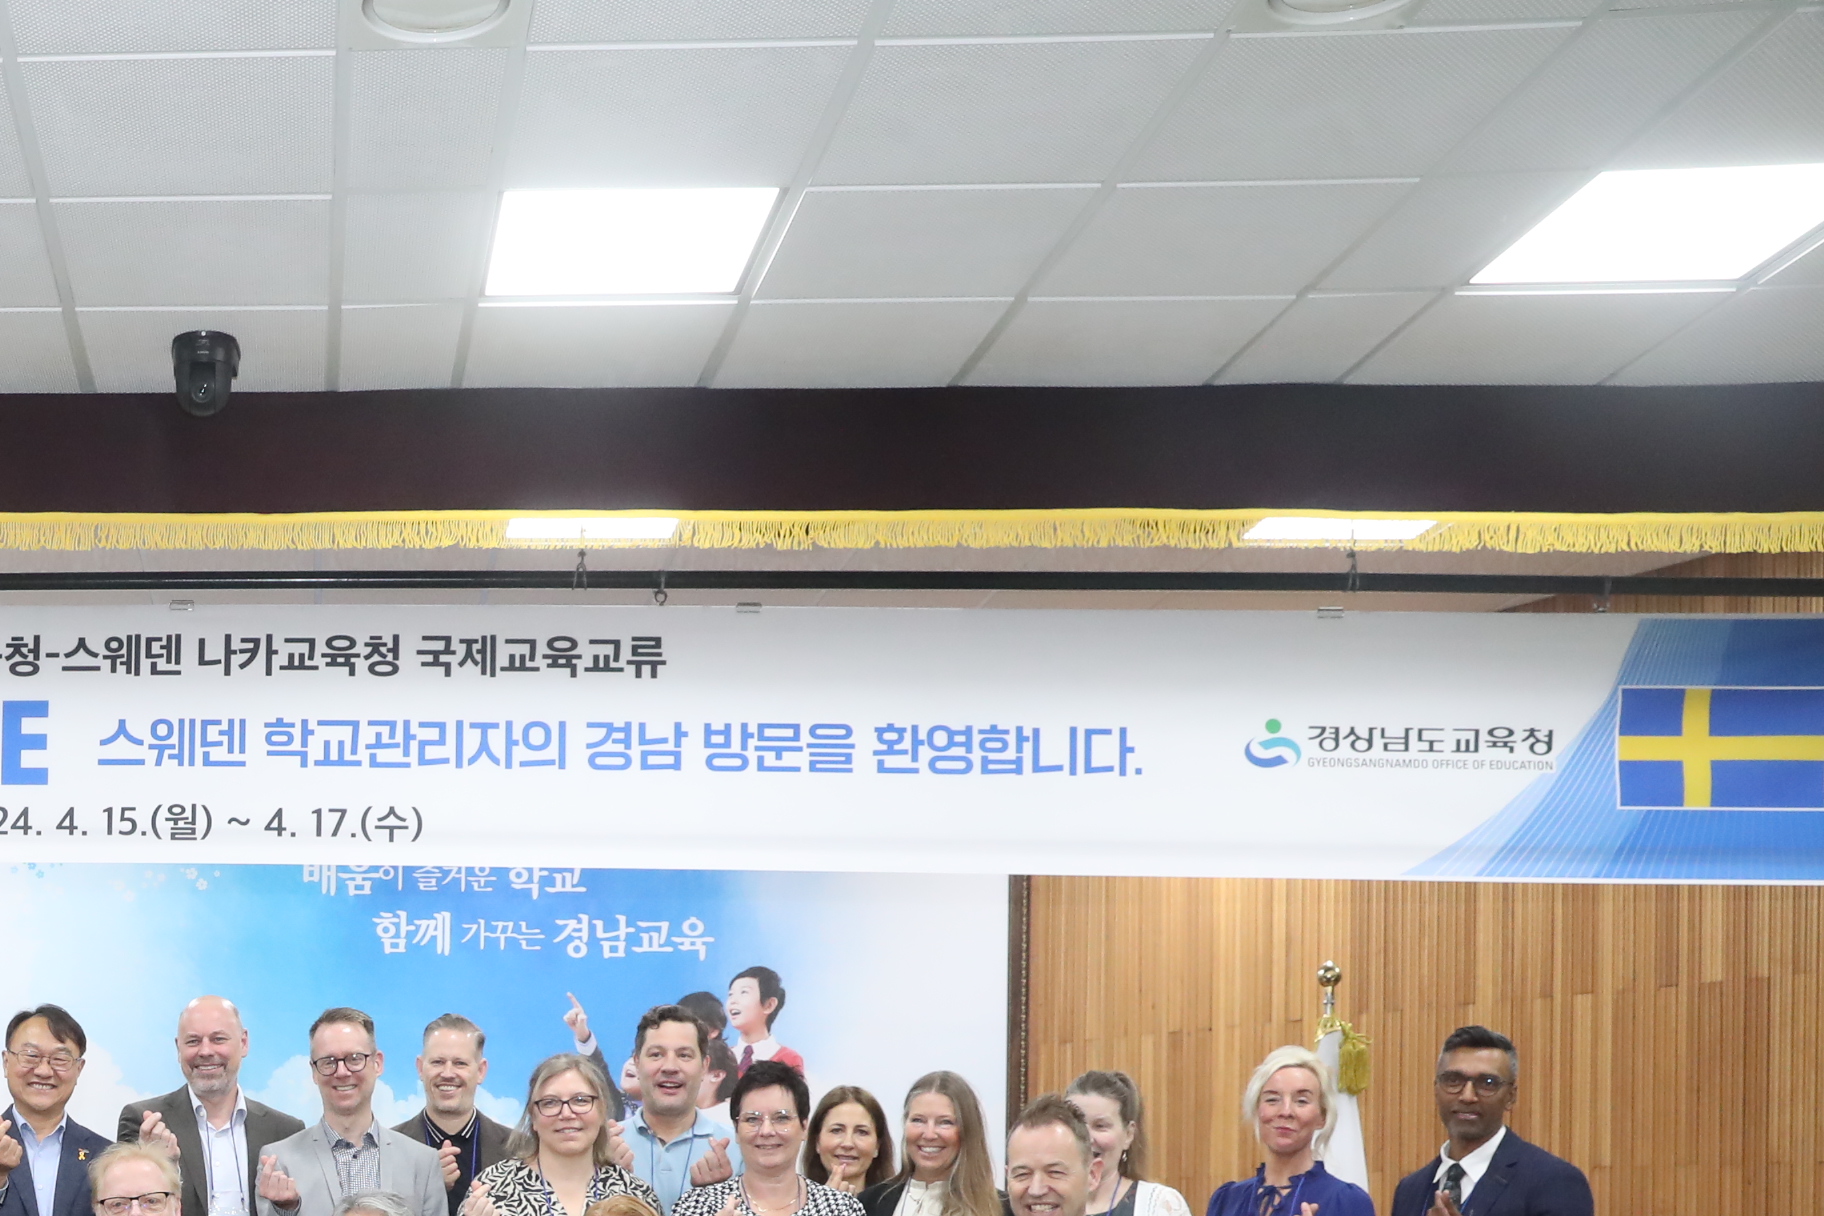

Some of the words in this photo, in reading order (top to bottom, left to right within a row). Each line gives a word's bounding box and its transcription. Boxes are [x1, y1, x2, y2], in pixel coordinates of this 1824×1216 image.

[197, 633, 401, 677] 나카교육청
[415, 634, 667, 679] 국제교육교류
[97, 717, 248, 768] 스웨덴
[263, 717, 568, 771] 학교관리자의
[585, 720, 689, 772] 경남
[703, 722, 857, 774] 방문을
[873, 722, 1144, 778] 환영합니다.
[1307, 725, 1555, 757] 경상남도교육청
[1307, 757, 1429, 770] GYEONGSANGNAMDO
[1431, 759, 1470, 770] OFFICE
[1473, 759, 1488, 771] OF
[1488, 759, 1554, 772] EDUCATION
[56, 806, 88, 838] 4.
[102, 803, 213, 841] 15.(월)
[264, 806, 297, 839] 4.
[310, 805, 424, 843] 17.(수)
[371, 909, 452, 957] 함께
[460, 918, 546, 951] 가꾸는
[552, 912, 716, 962] 경남교육
